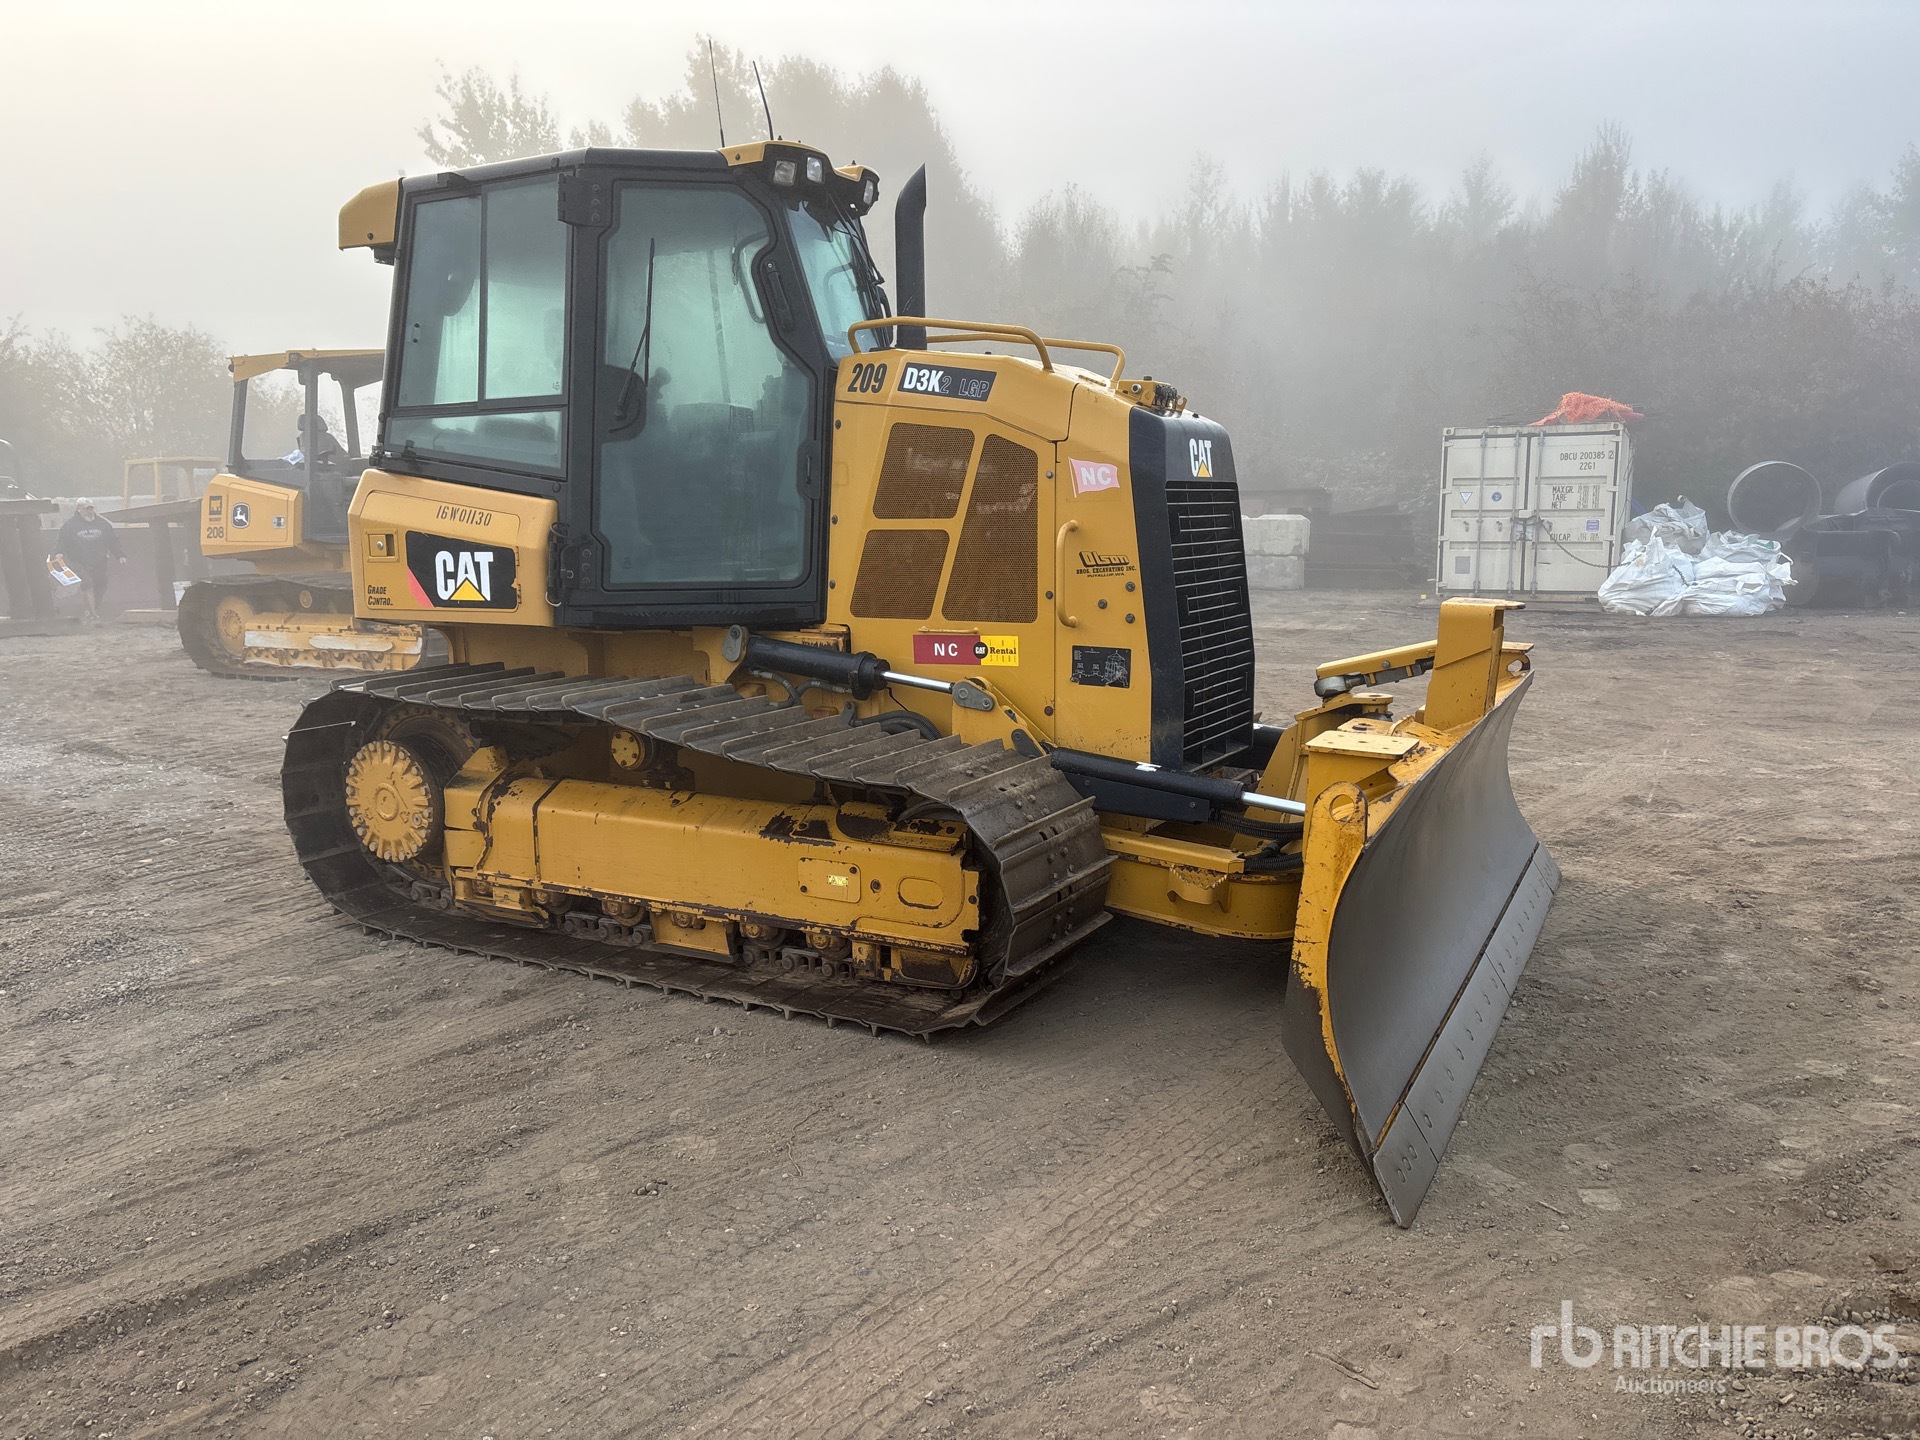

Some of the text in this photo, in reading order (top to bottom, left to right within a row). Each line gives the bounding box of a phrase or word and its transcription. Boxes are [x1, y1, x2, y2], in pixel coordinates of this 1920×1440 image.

[847, 363, 888, 394] 209
[958, 378, 989, 398] LGP
[1189, 438, 1213, 477] CAT
[1579, 451, 1606, 460] 200385
[1579, 462, 1596, 470] 22G1
[1080, 467, 1112, 486] NC
[1552, 493, 1567, 502] TARE
[1551, 501, 1562, 509] NET
[436, 505, 492, 527] 16W01130
[207, 526, 224, 539] 208
[435, 551, 494, 601] CAT
[934, 643, 958, 657] NC
[990, 646, 1017, 655] Rental
